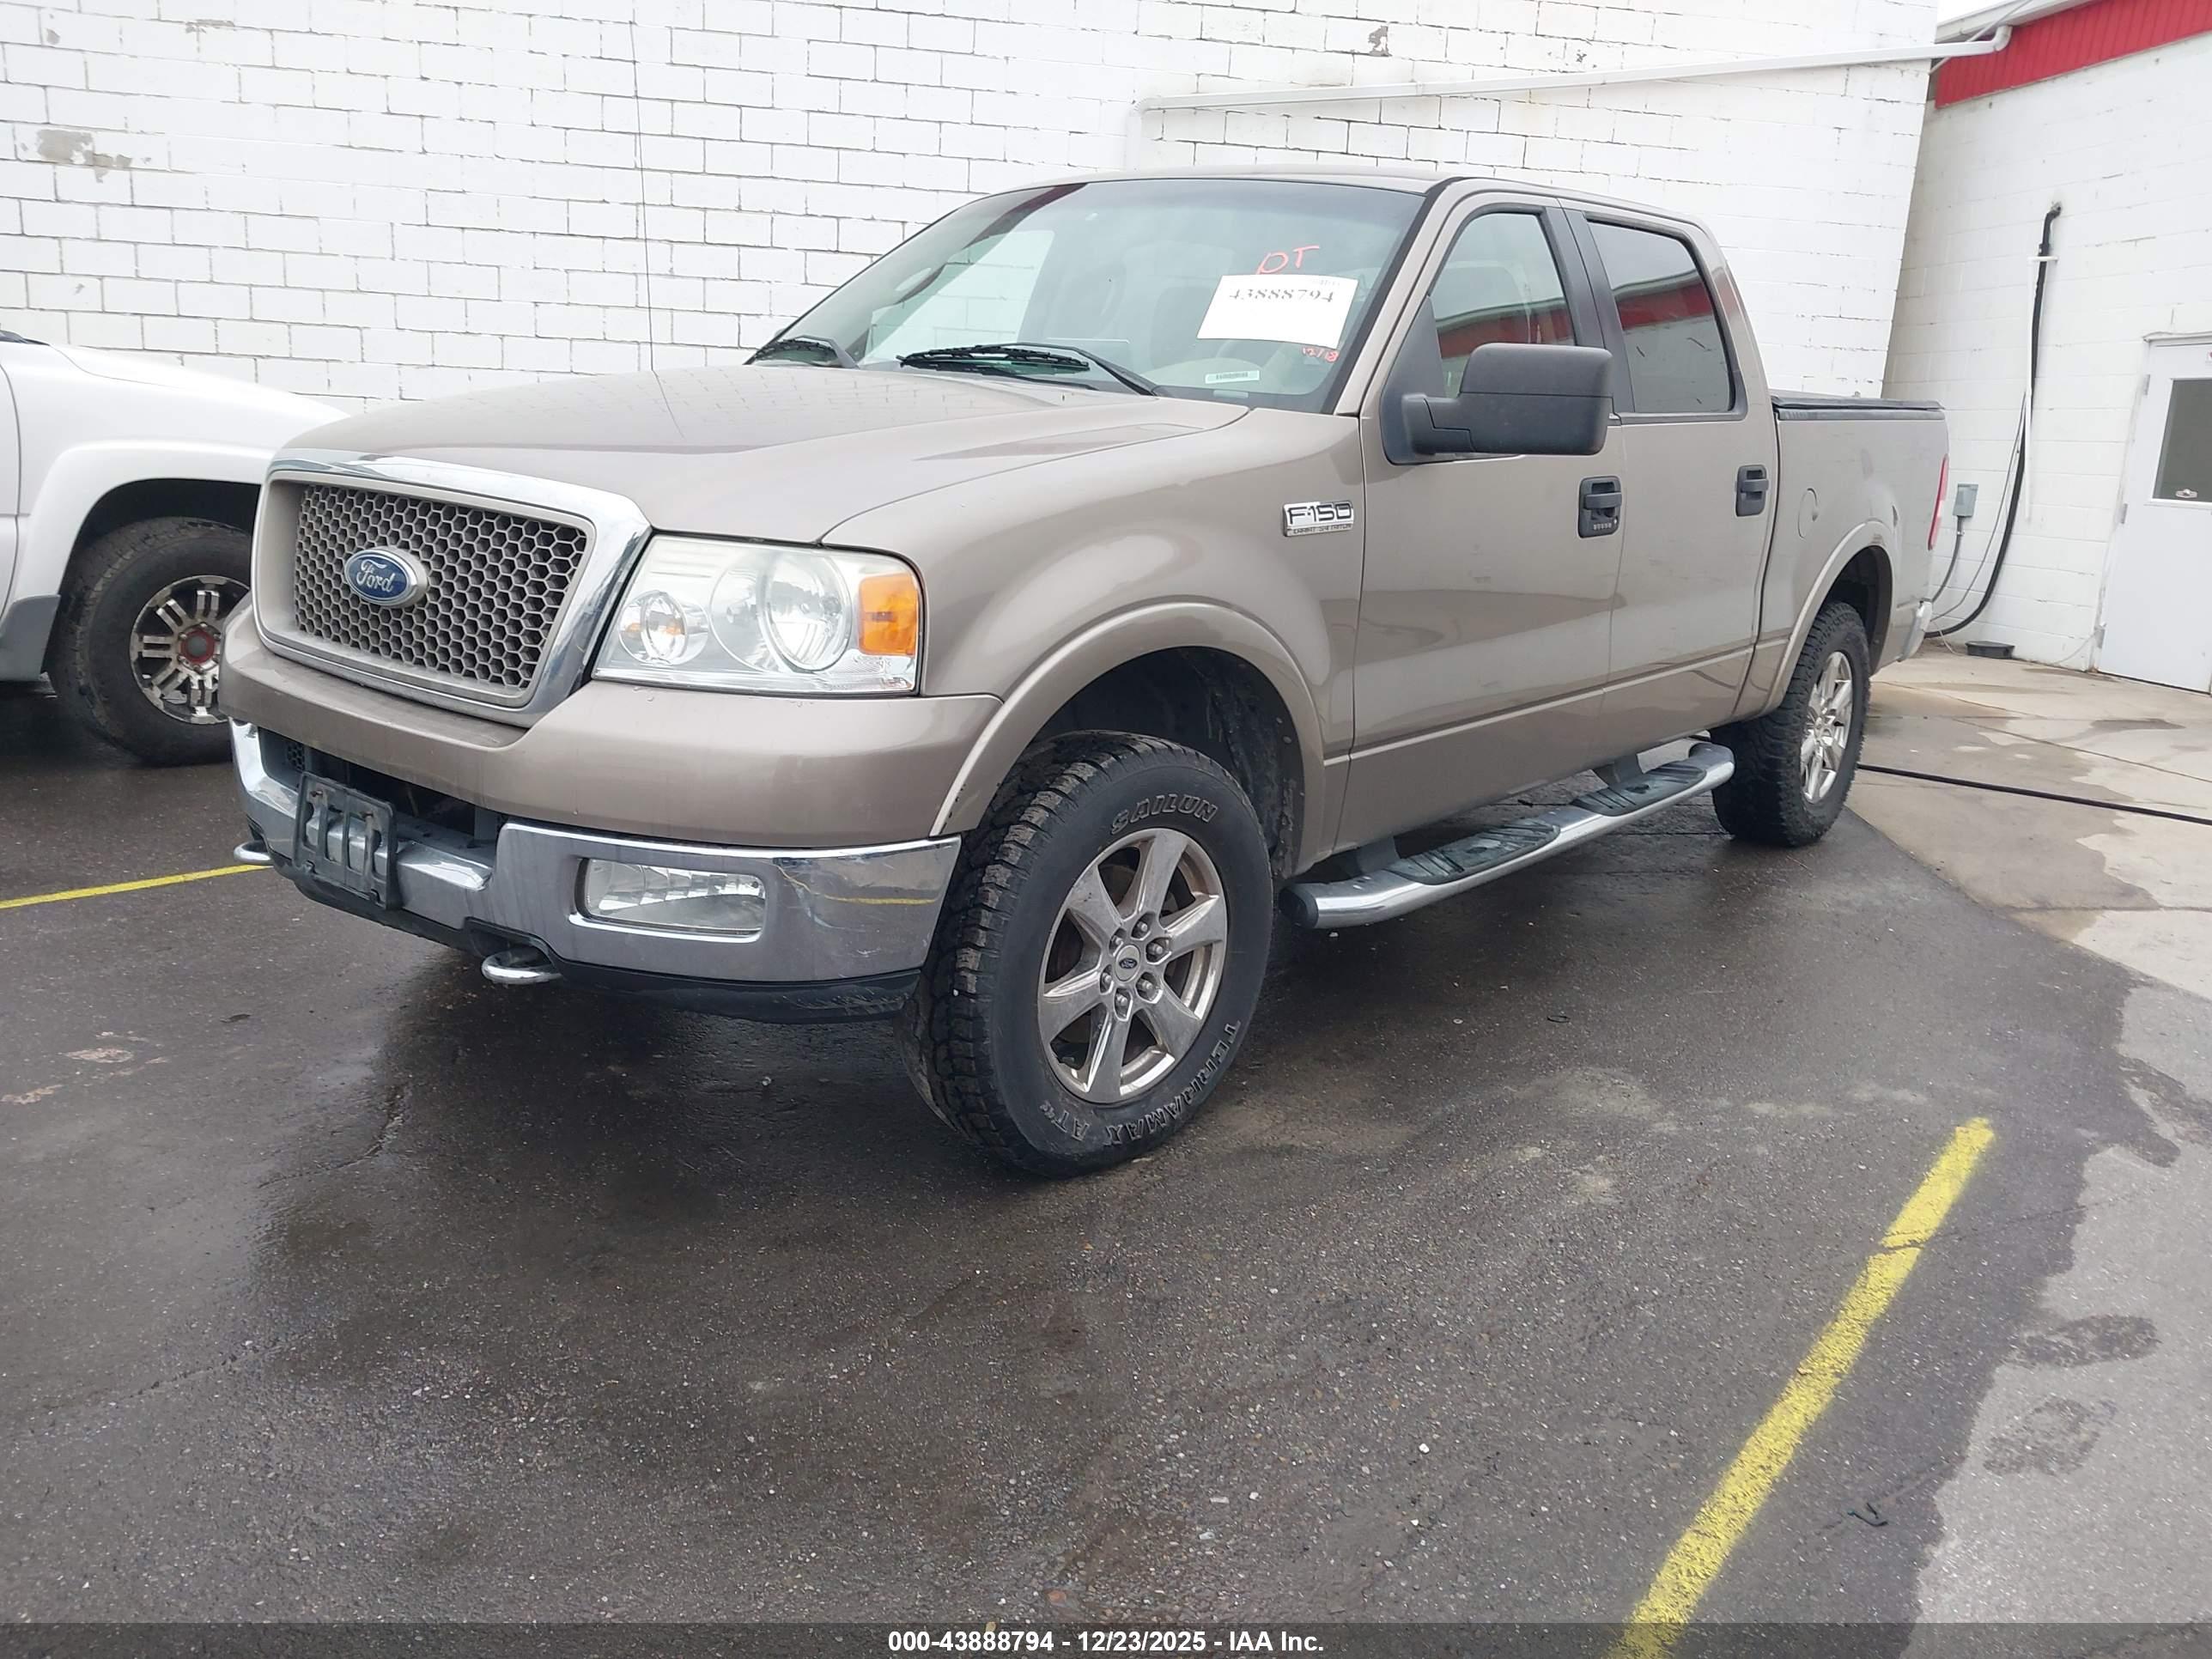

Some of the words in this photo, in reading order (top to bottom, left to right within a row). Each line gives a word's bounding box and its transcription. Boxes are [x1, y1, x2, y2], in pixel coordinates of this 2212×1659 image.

[1229, 288, 1334, 302] 43888794
[356, 558, 396, 593] Ford
[1111, 793, 1218, 835] SAILUN
[1103, 1020, 1242, 1146] TERRAMAX
